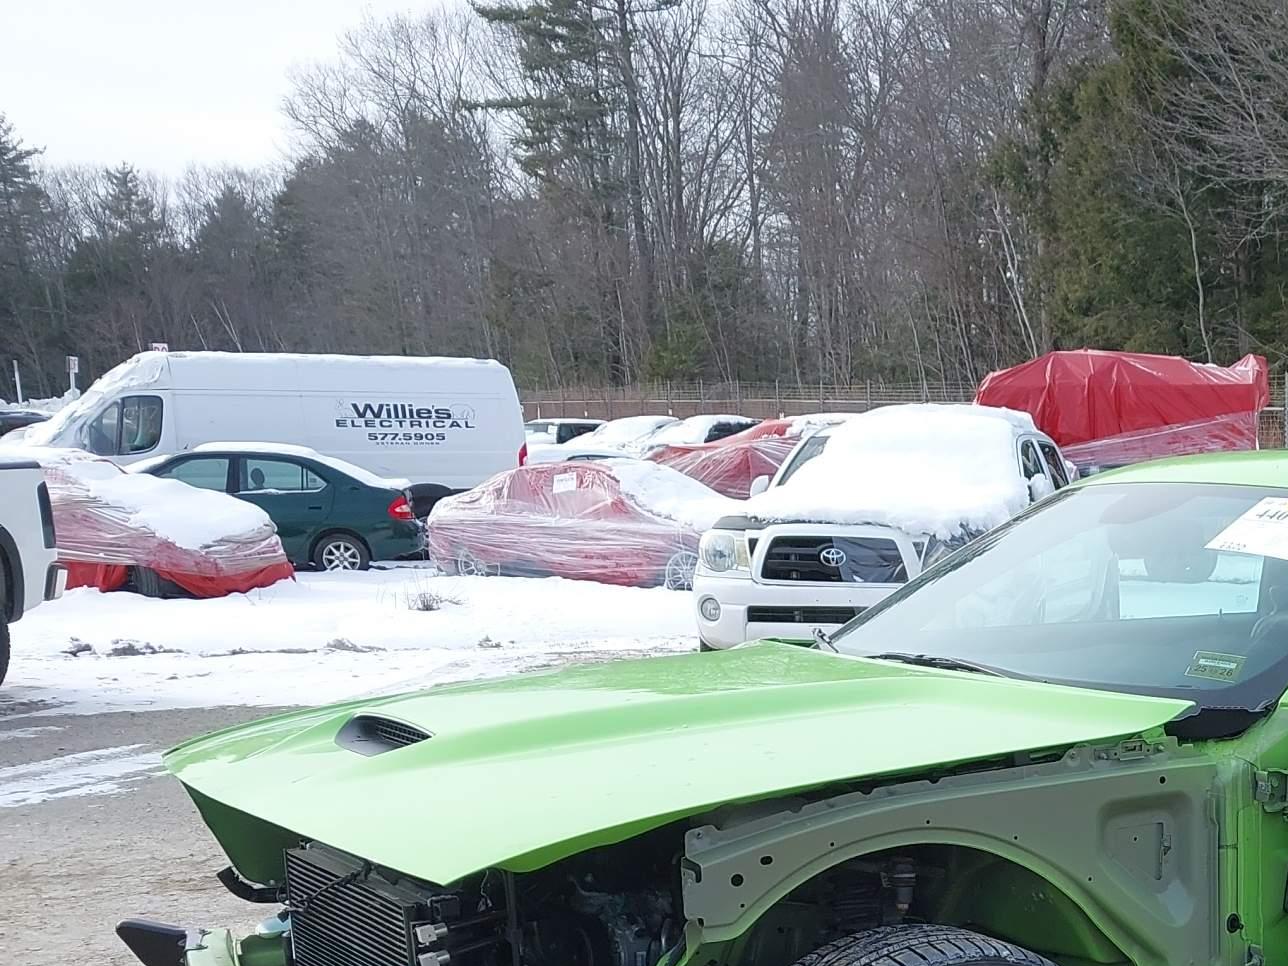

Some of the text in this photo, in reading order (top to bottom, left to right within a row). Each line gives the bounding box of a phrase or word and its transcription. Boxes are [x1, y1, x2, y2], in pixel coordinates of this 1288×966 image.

[350, 403, 453, 420] Willie's
[335, 419, 476, 429] ELECTRICAL
[367, 432, 447, 441] 577.5905
[1219, 668, 1234, 677] 26
